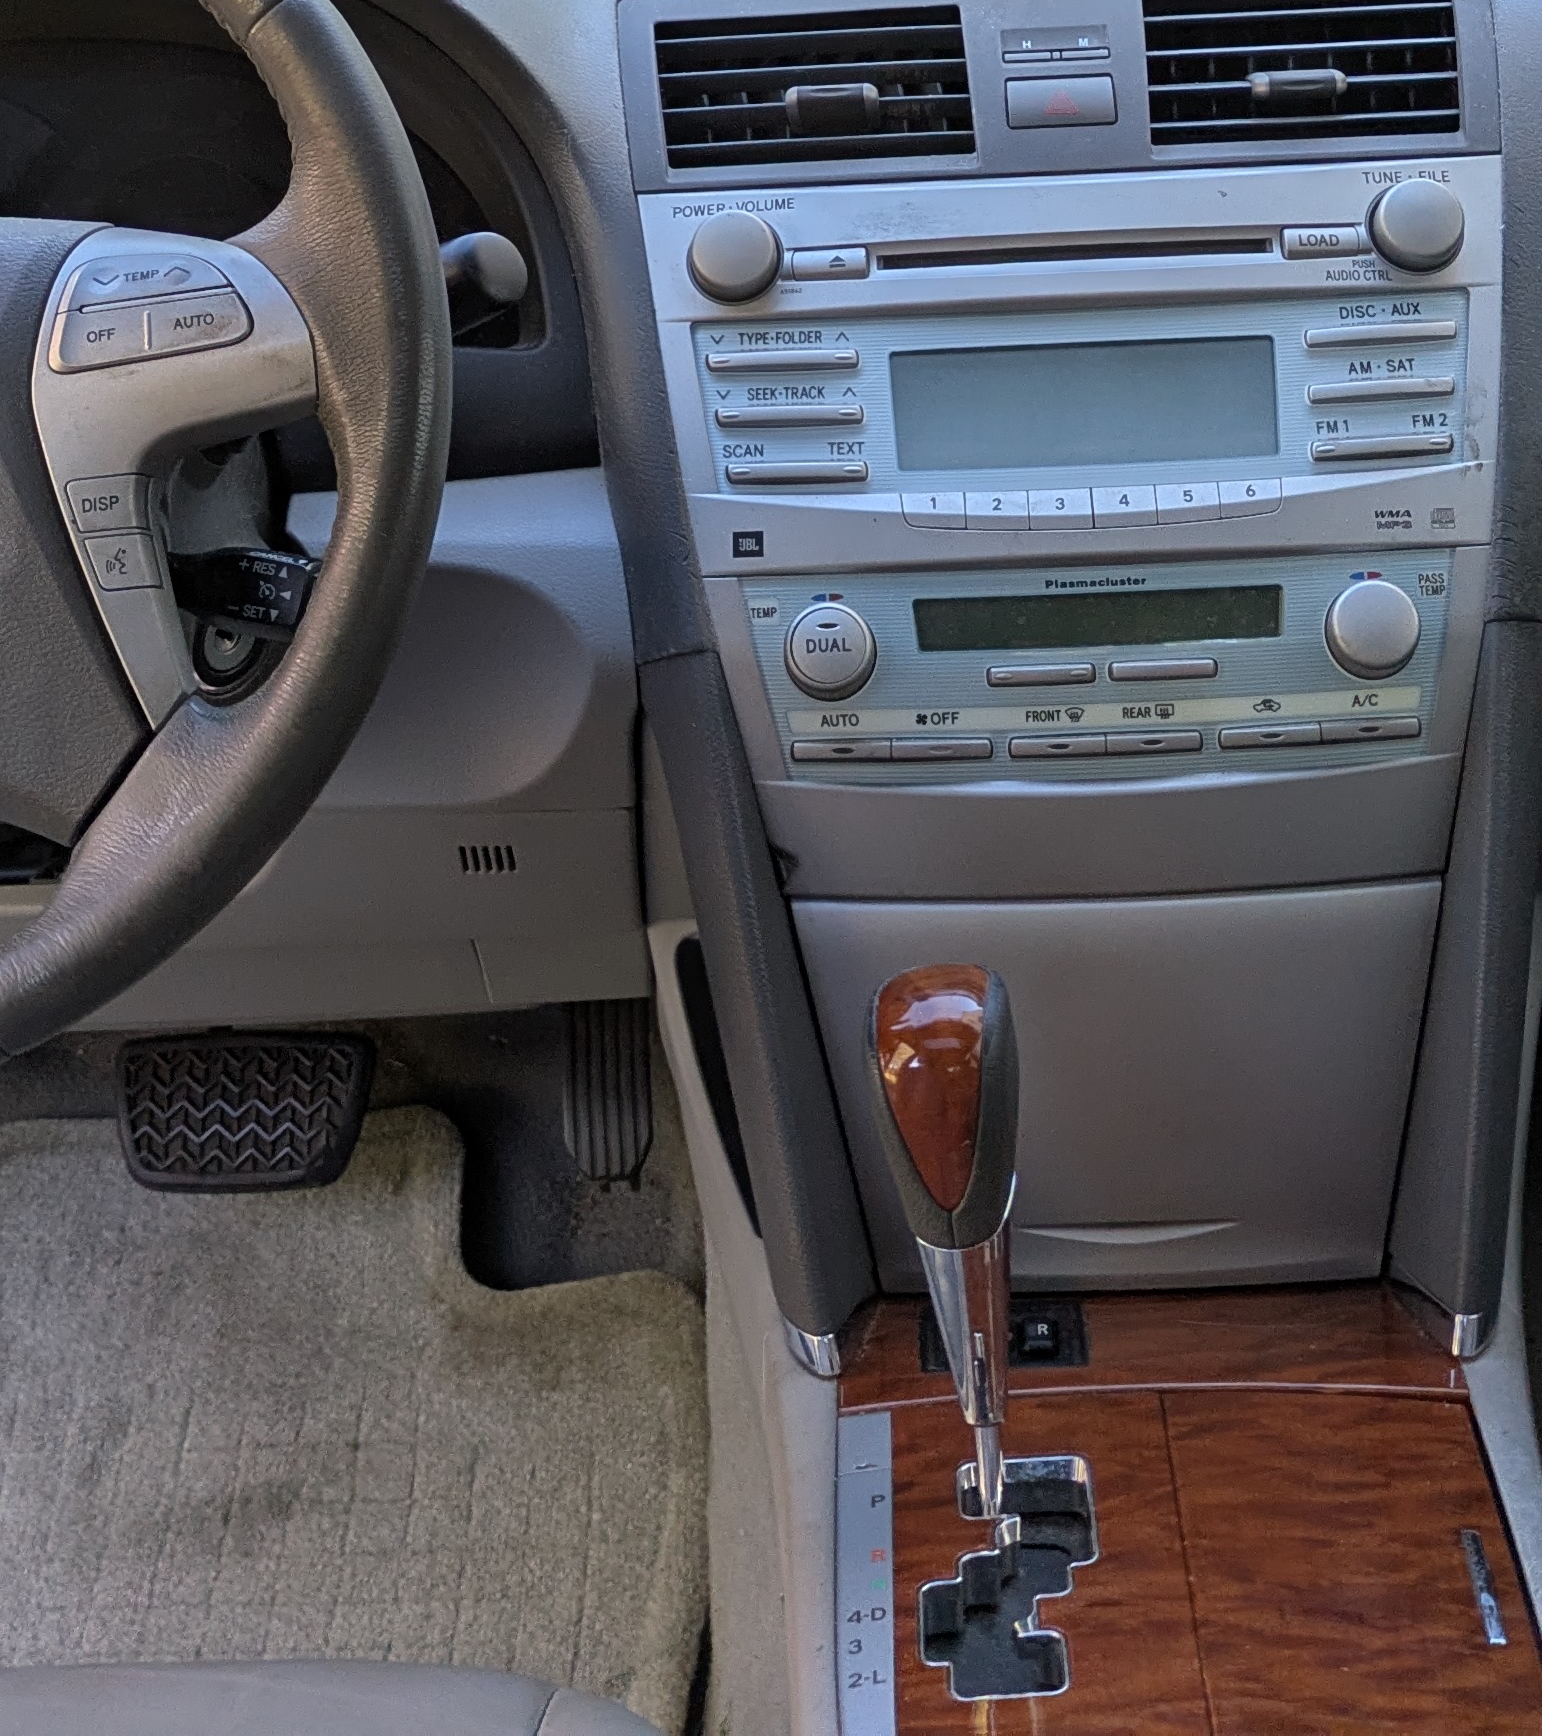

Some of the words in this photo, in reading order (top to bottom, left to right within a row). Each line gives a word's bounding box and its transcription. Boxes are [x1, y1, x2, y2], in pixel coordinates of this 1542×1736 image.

[1022, 40, 1032, 49] H
[1298, 234, 1340, 247] LOAD
[1351, 259, 1376, 269] PUSH
[123, 269, 160, 282] TEMP
[1325, 269, 1360, 282] AUDIO
[1362, 269, 1392, 281] CTRL
[1338, 305, 1376, 319] DISC
[1391, 302, 1422, 317] AUX
[173, 313, 215, 331] AUTO
[86, 328, 116, 343] OFF
[1348, 362, 1372, 376] AM
[1386, 358, 1416, 372] SAT
[722, 443, 765, 459] SCAN
[827, 441, 865, 455] TEXT
[81, 495, 120, 513] DISP
[929, 497, 937, 509] 1
[991, 498, 1002, 511] 2
[1054, 497, 1065, 511] 3
[1118, 494, 1130, 507] 4
[1182, 489, 1194, 503] 5
[1245, 485, 1256, 498] 6
[1374, 509, 1412, 519] WMA
[738, 537, 760, 551] JBL
[252, 560, 277, 576] RES
[1045, 575, 1147, 589] Plasmacluster
[1418, 572, 1445, 585] PASS
[1419, 584, 1446, 596] TEMP
[242, 603, 264, 619] SET
[750, 606, 778, 619] TEMP
[805, 637, 853, 654] DUAL
[1352, 694, 1379, 708] A/C
[930, 711, 960, 726] OFF
[1025, 710, 1062, 723] FRONT
[1122, 706, 1152, 720] REAR
[820, 713, 860, 728] AUTO
[1036, 1322, 1048, 1336] R
[870, 1494, 886, 1509] P
[870, 1548, 886, 1563] R
[848, 1639, 863, 1656] 3
